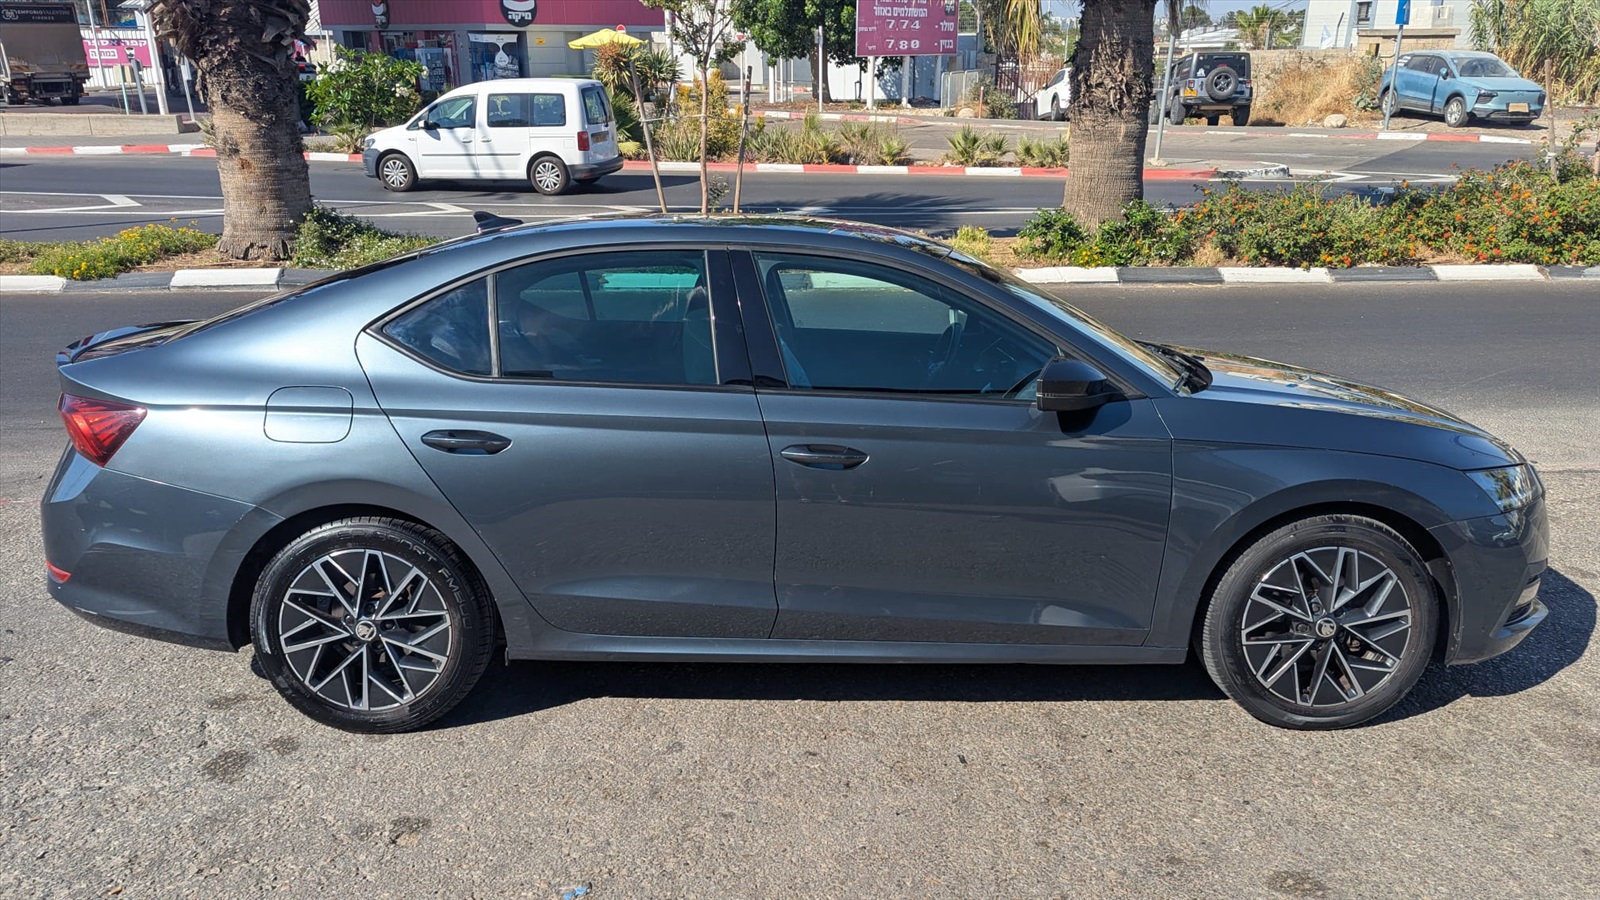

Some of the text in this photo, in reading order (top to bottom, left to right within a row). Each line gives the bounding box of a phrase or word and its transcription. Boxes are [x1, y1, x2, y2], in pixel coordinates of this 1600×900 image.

[507, 11, 532, 23] מיקה
[873, 6, 928, 18] המשתלמים באזור
[886, 19, 920, 31] 7.74
[940, 20, 955, 32] סולר
[121, 39, 147, 47] קפה
[886, 39, 920, 51] 7.80
[940, 39, 954, 53] בנזין
[90, 50, 116, 58] במתה
